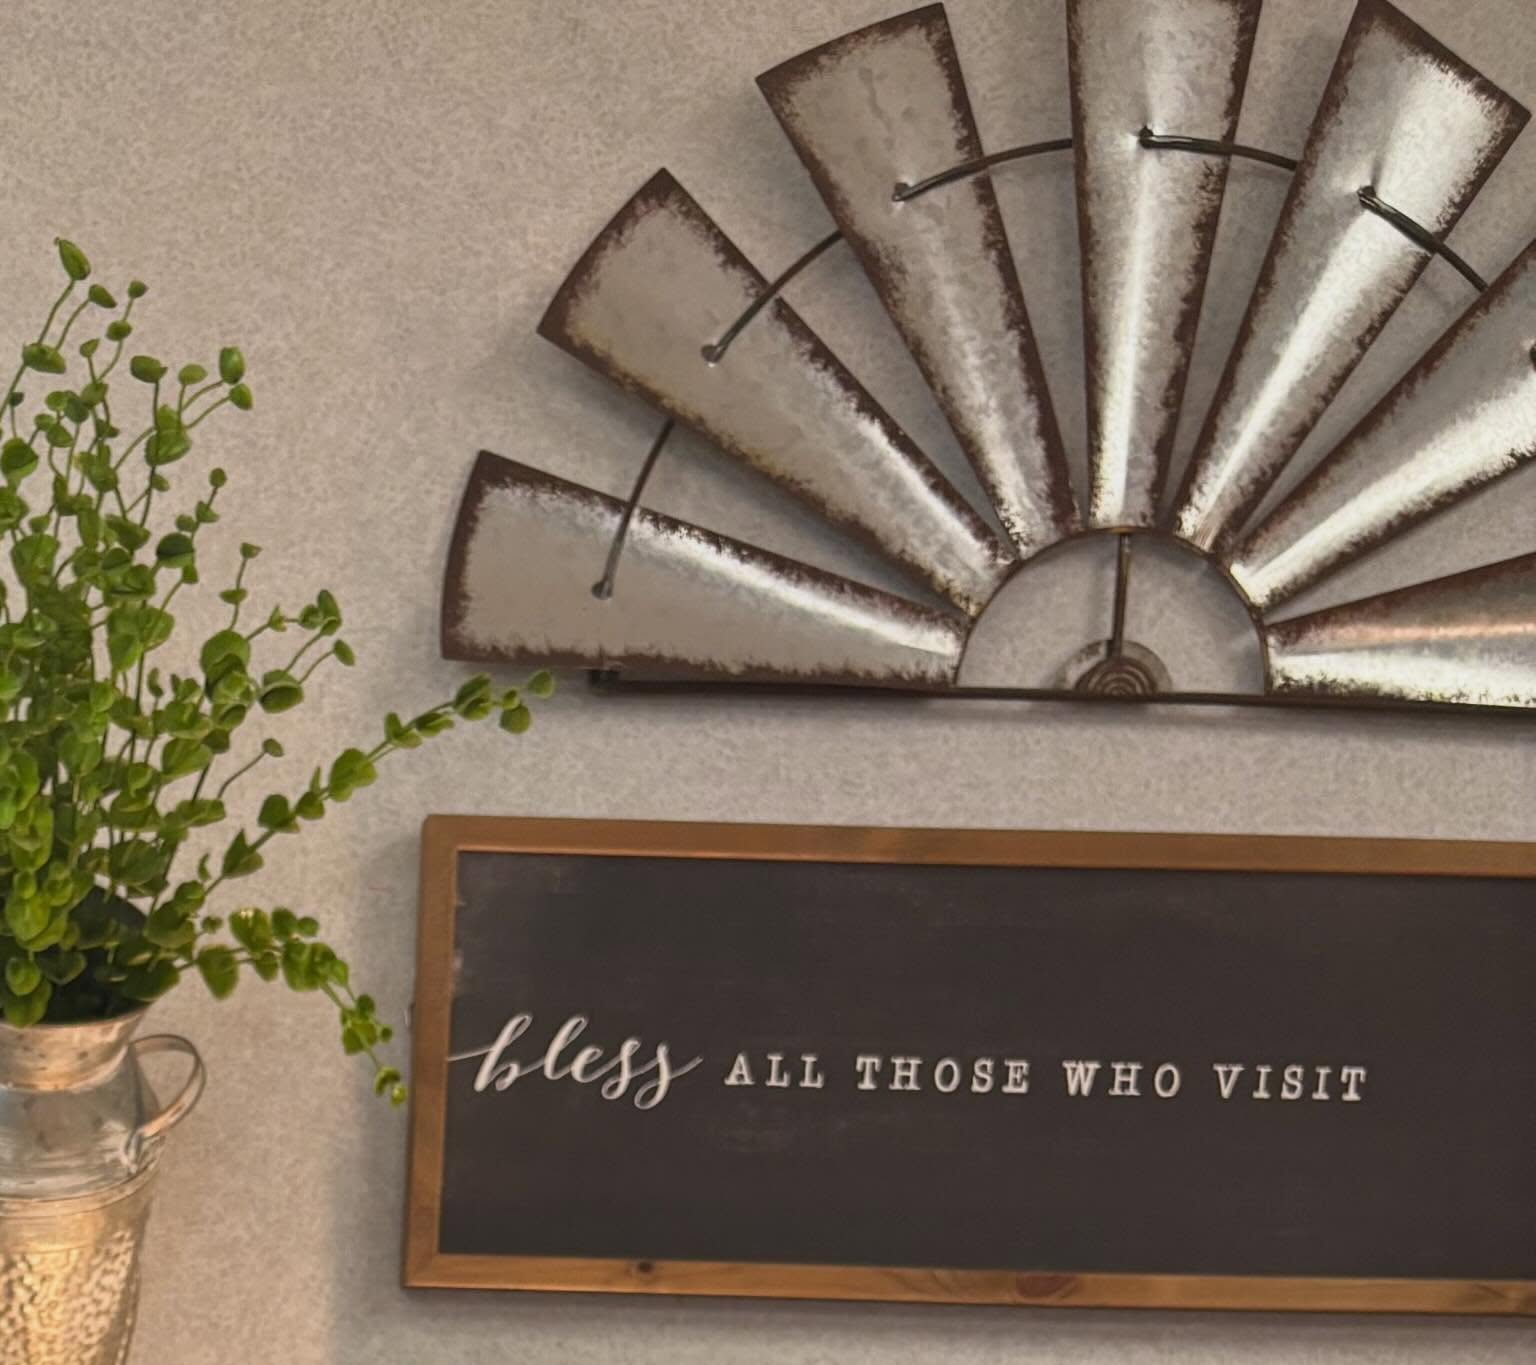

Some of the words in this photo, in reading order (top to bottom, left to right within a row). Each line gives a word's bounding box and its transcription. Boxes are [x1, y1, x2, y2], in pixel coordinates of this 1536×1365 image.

[448, 1013, 704, 1110] bless
[724, 1053, 825, 1090] ALL
[855, 1055, 1031, 1095] THOSE
[1062, 1060, 1182, 1098] WHO
[1213, 1063, 1366, 1102] VISIT
